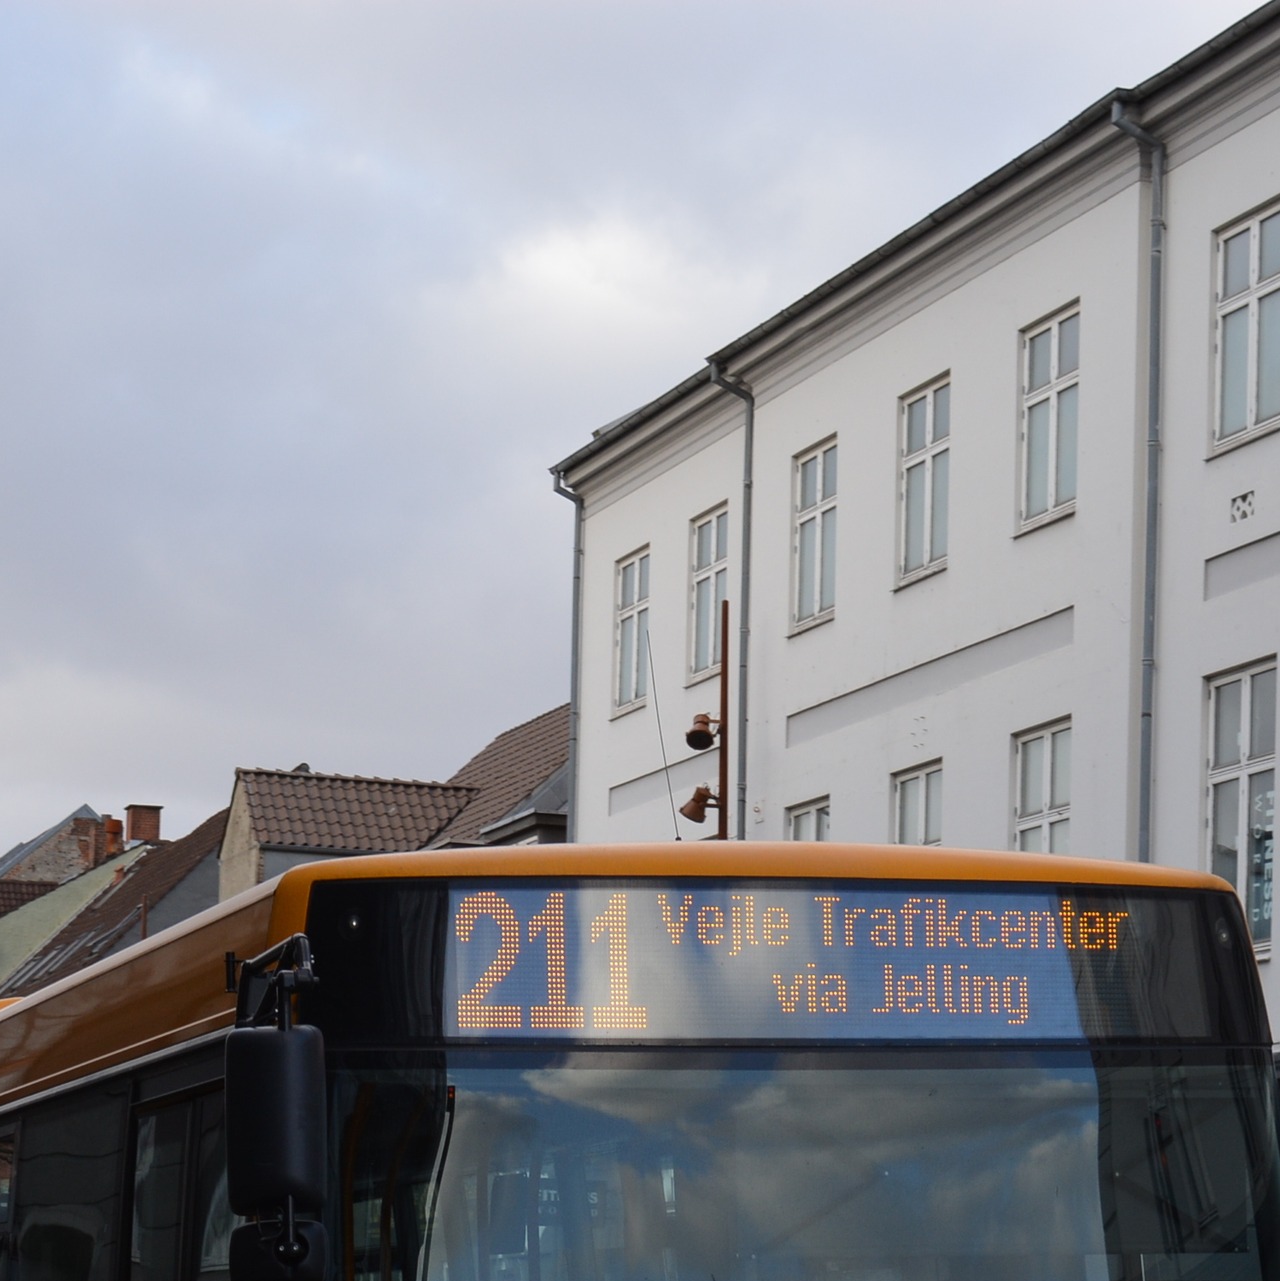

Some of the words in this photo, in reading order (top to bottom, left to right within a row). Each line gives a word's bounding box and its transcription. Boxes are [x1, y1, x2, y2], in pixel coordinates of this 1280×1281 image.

[657, 894, 790, 957] Vejle
[814, 896, 1128, 950] Trafikcenter
[456, 892, 647, 1029] 211
[772, 963, 848, 1013] via
[872, 964, 1028, 1024] Jelling
